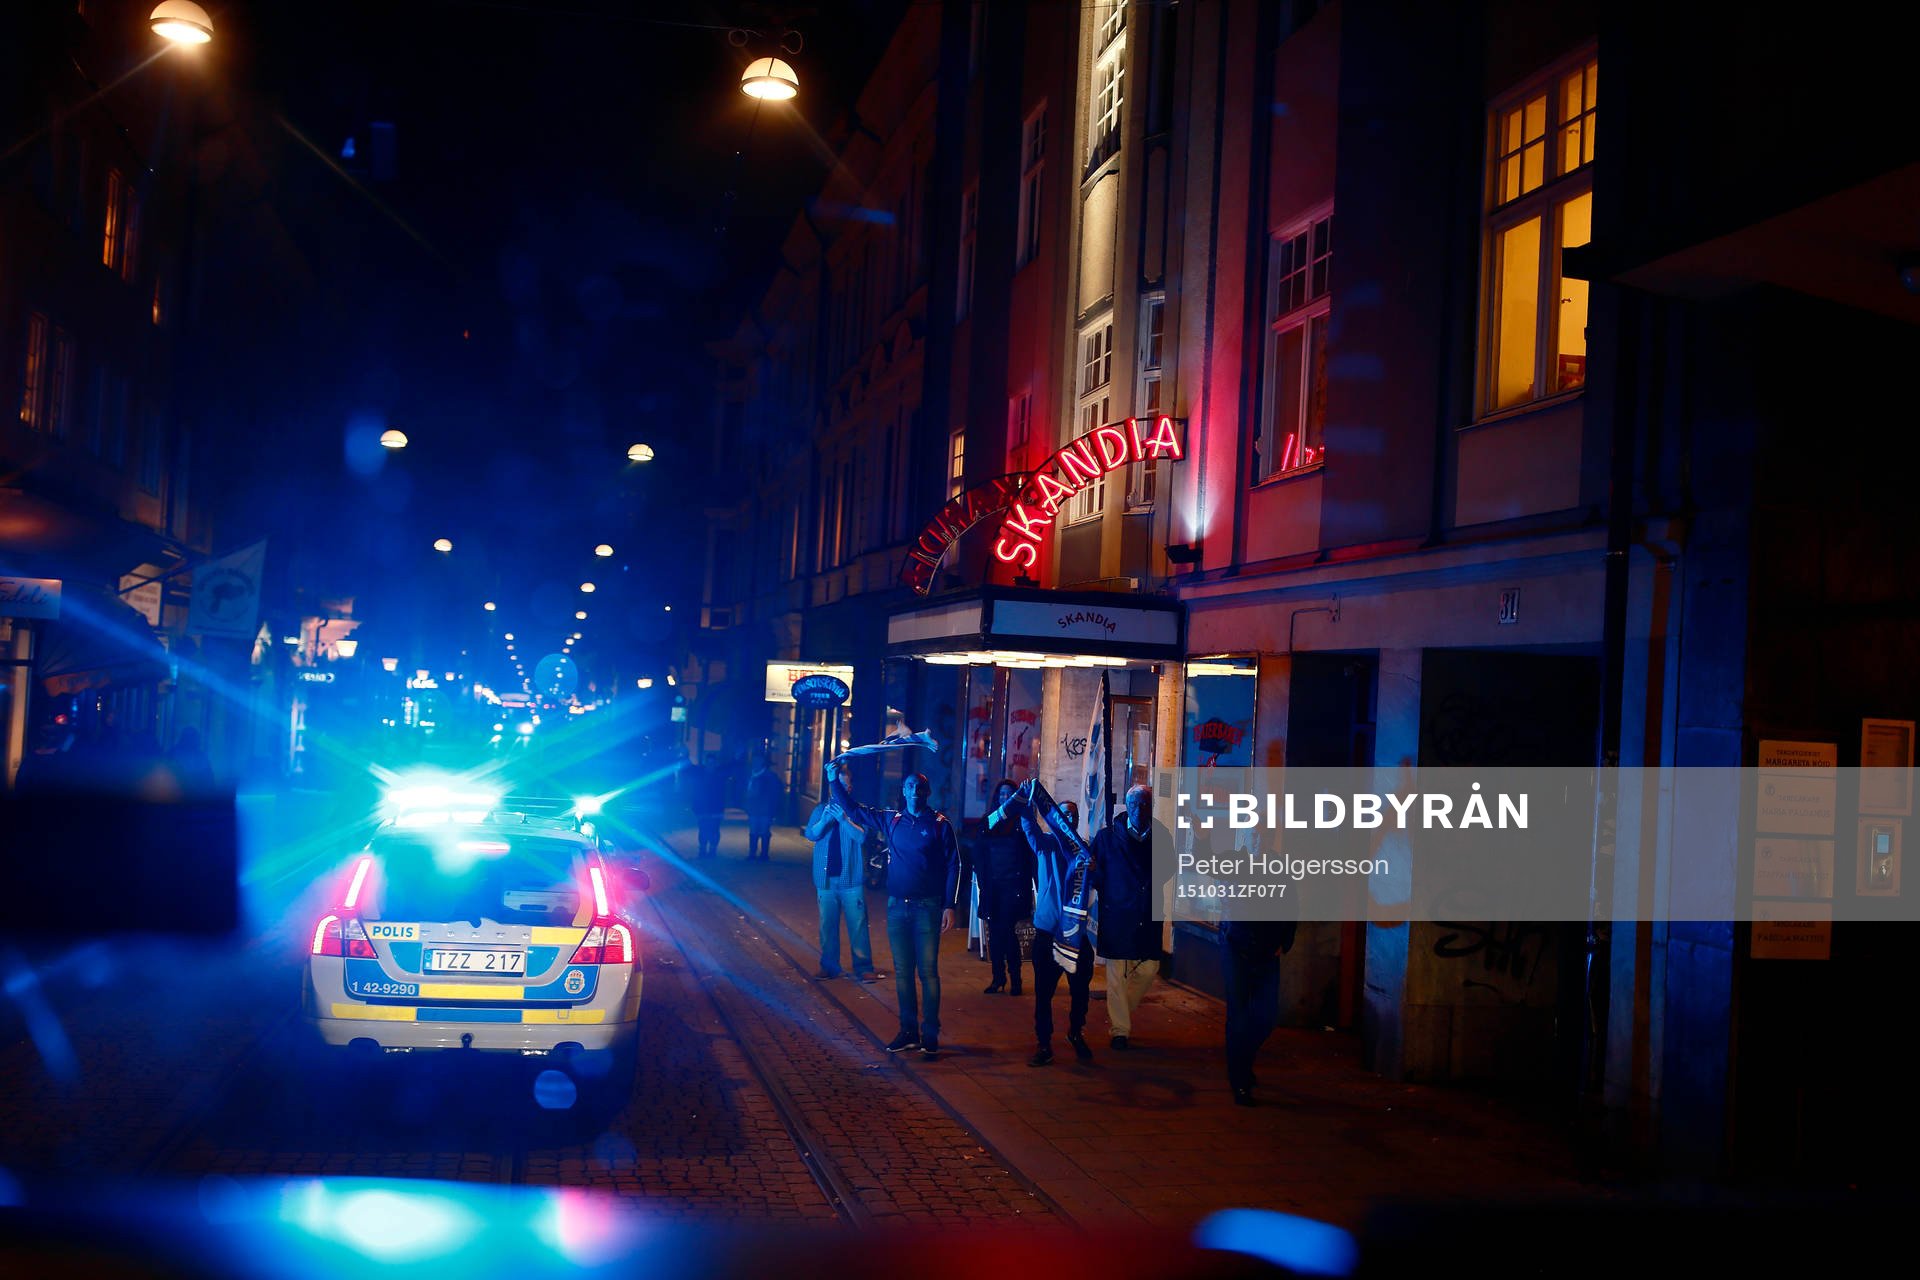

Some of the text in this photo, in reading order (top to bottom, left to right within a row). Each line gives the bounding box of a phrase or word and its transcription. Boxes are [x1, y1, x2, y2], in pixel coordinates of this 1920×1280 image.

[994, 415, 1184, 569] SKANDIA
[1057, 611, 1117, 634] SKANDIA
[372, 926, 414, 937] POLIS
[436, 952, 521, 970] TZZ 217
[352, 981, 416, 995] 1 42-9290
